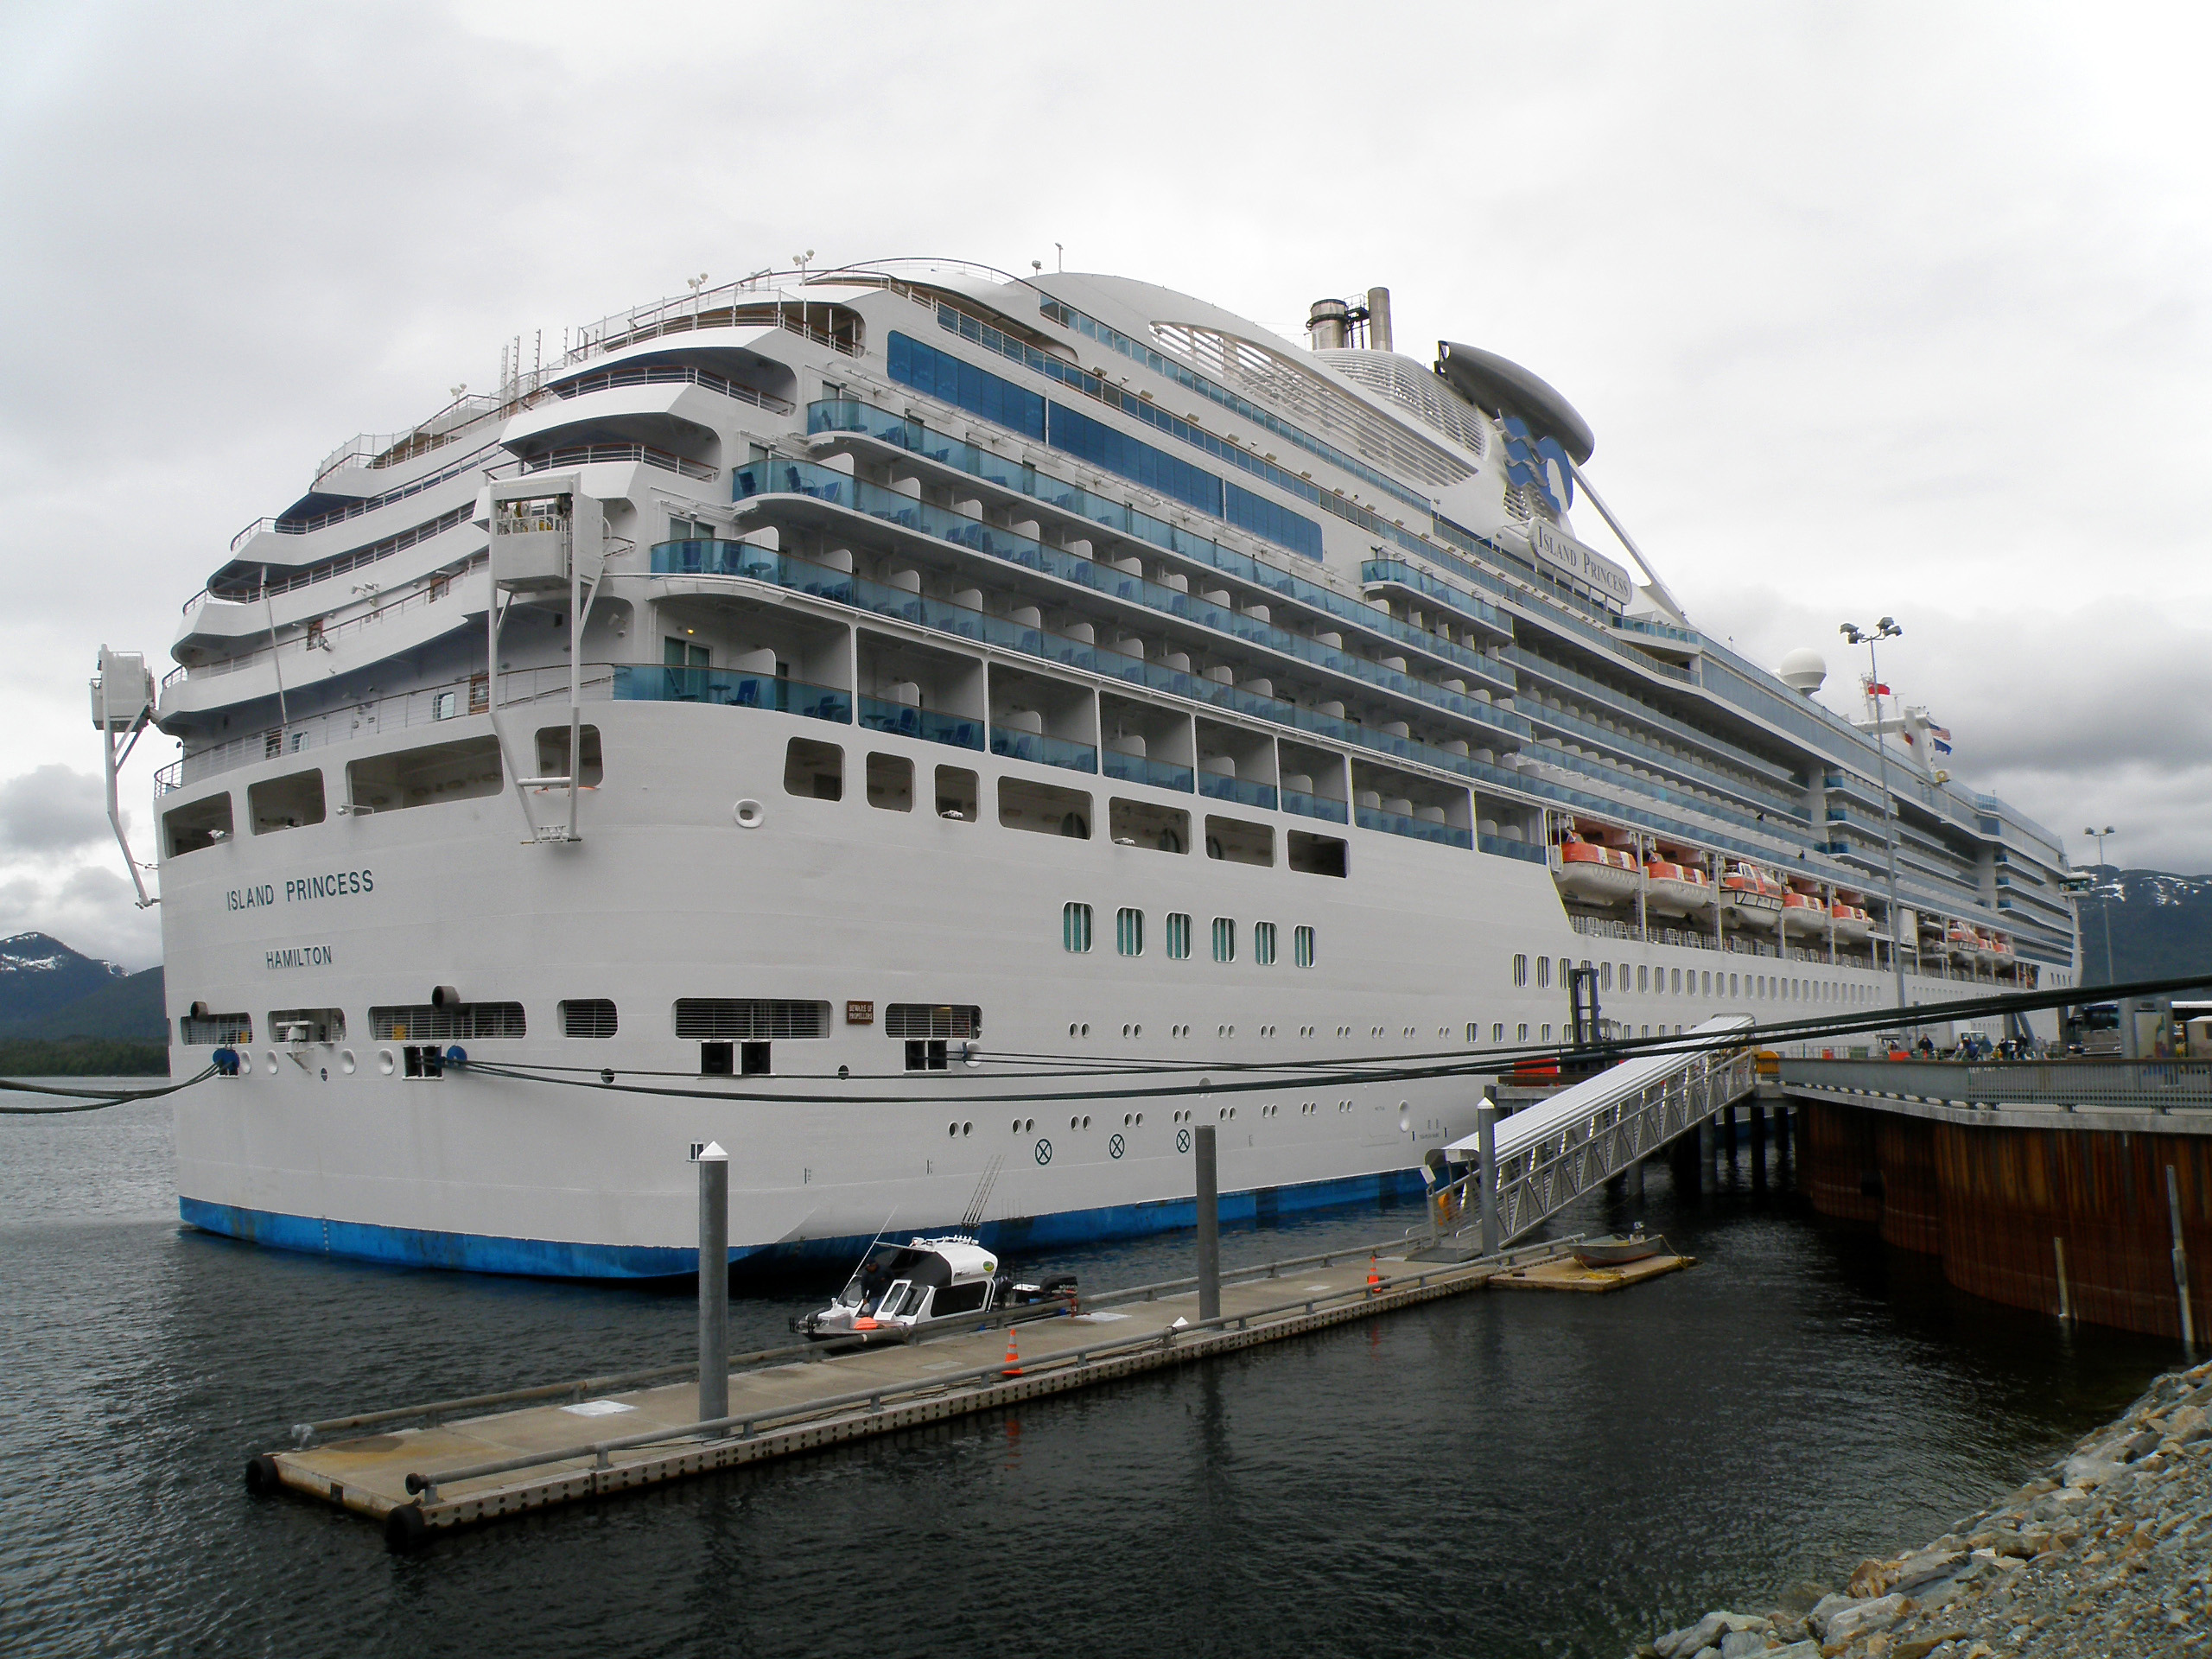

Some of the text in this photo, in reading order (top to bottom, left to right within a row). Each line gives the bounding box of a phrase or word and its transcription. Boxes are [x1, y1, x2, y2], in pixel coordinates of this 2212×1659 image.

[1538, 525, 1629, 597] ISLAND PRINCESS
[226, 869, 374, 912] ISLAND PRINCESS
[265, 945, 333, 969] HAMILTON
